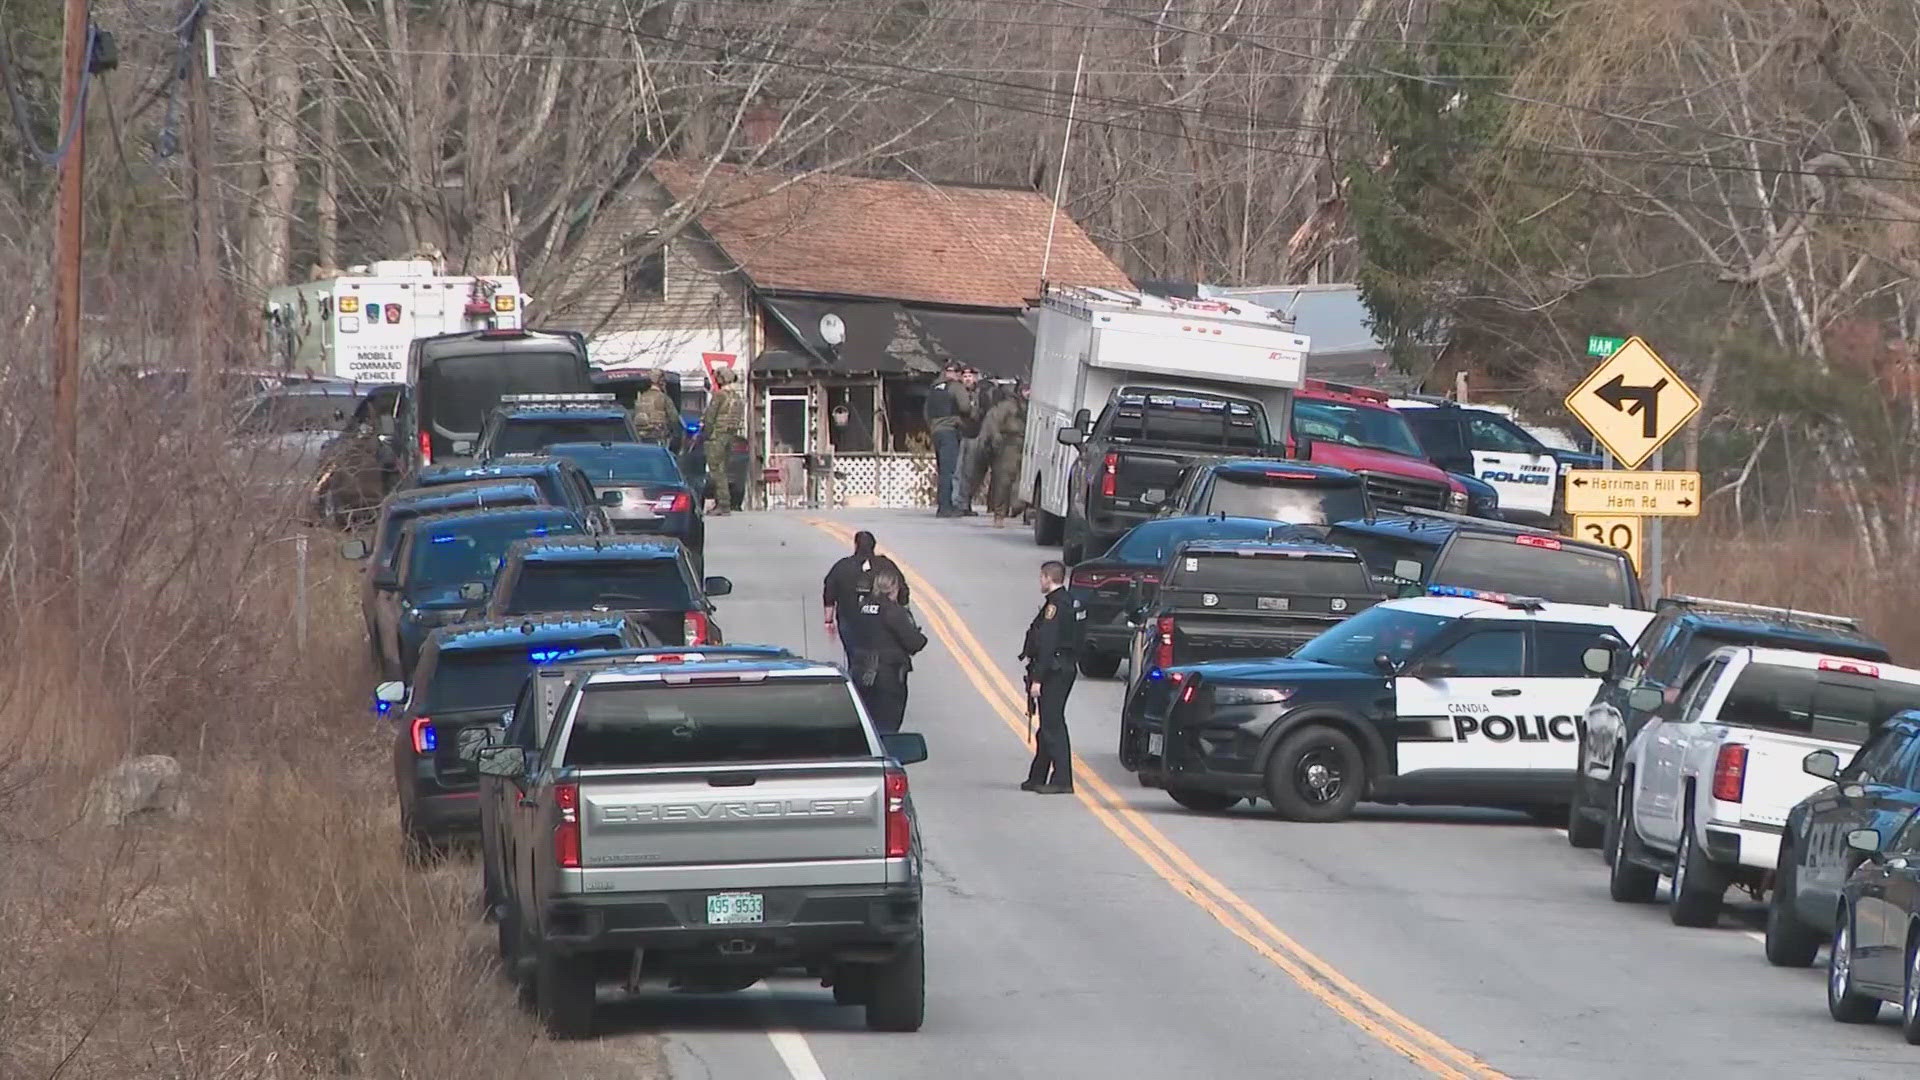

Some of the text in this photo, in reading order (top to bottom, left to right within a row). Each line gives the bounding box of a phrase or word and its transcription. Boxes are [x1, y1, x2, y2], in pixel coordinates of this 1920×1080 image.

[1589, 338, 1612, 353] HAM
[357, 351, 393, 360] MOBILE
[349, 361, 402, 370] COMMAND
[356, 371, 396, 380] VEHICLE
[1481, 471, 1549, 486] POLICE
[1592, 477, 1695, 491] Harriman Hill Rd
[1608, 496, 1657, 508] Ham Rd
[1585, 523, 1632, 550] 30
[1448, 703, 1490, 713] CANDIA
[601, 799, 865, 822] CHEVROLET
[709, 898, 762, 913] 495 9533
